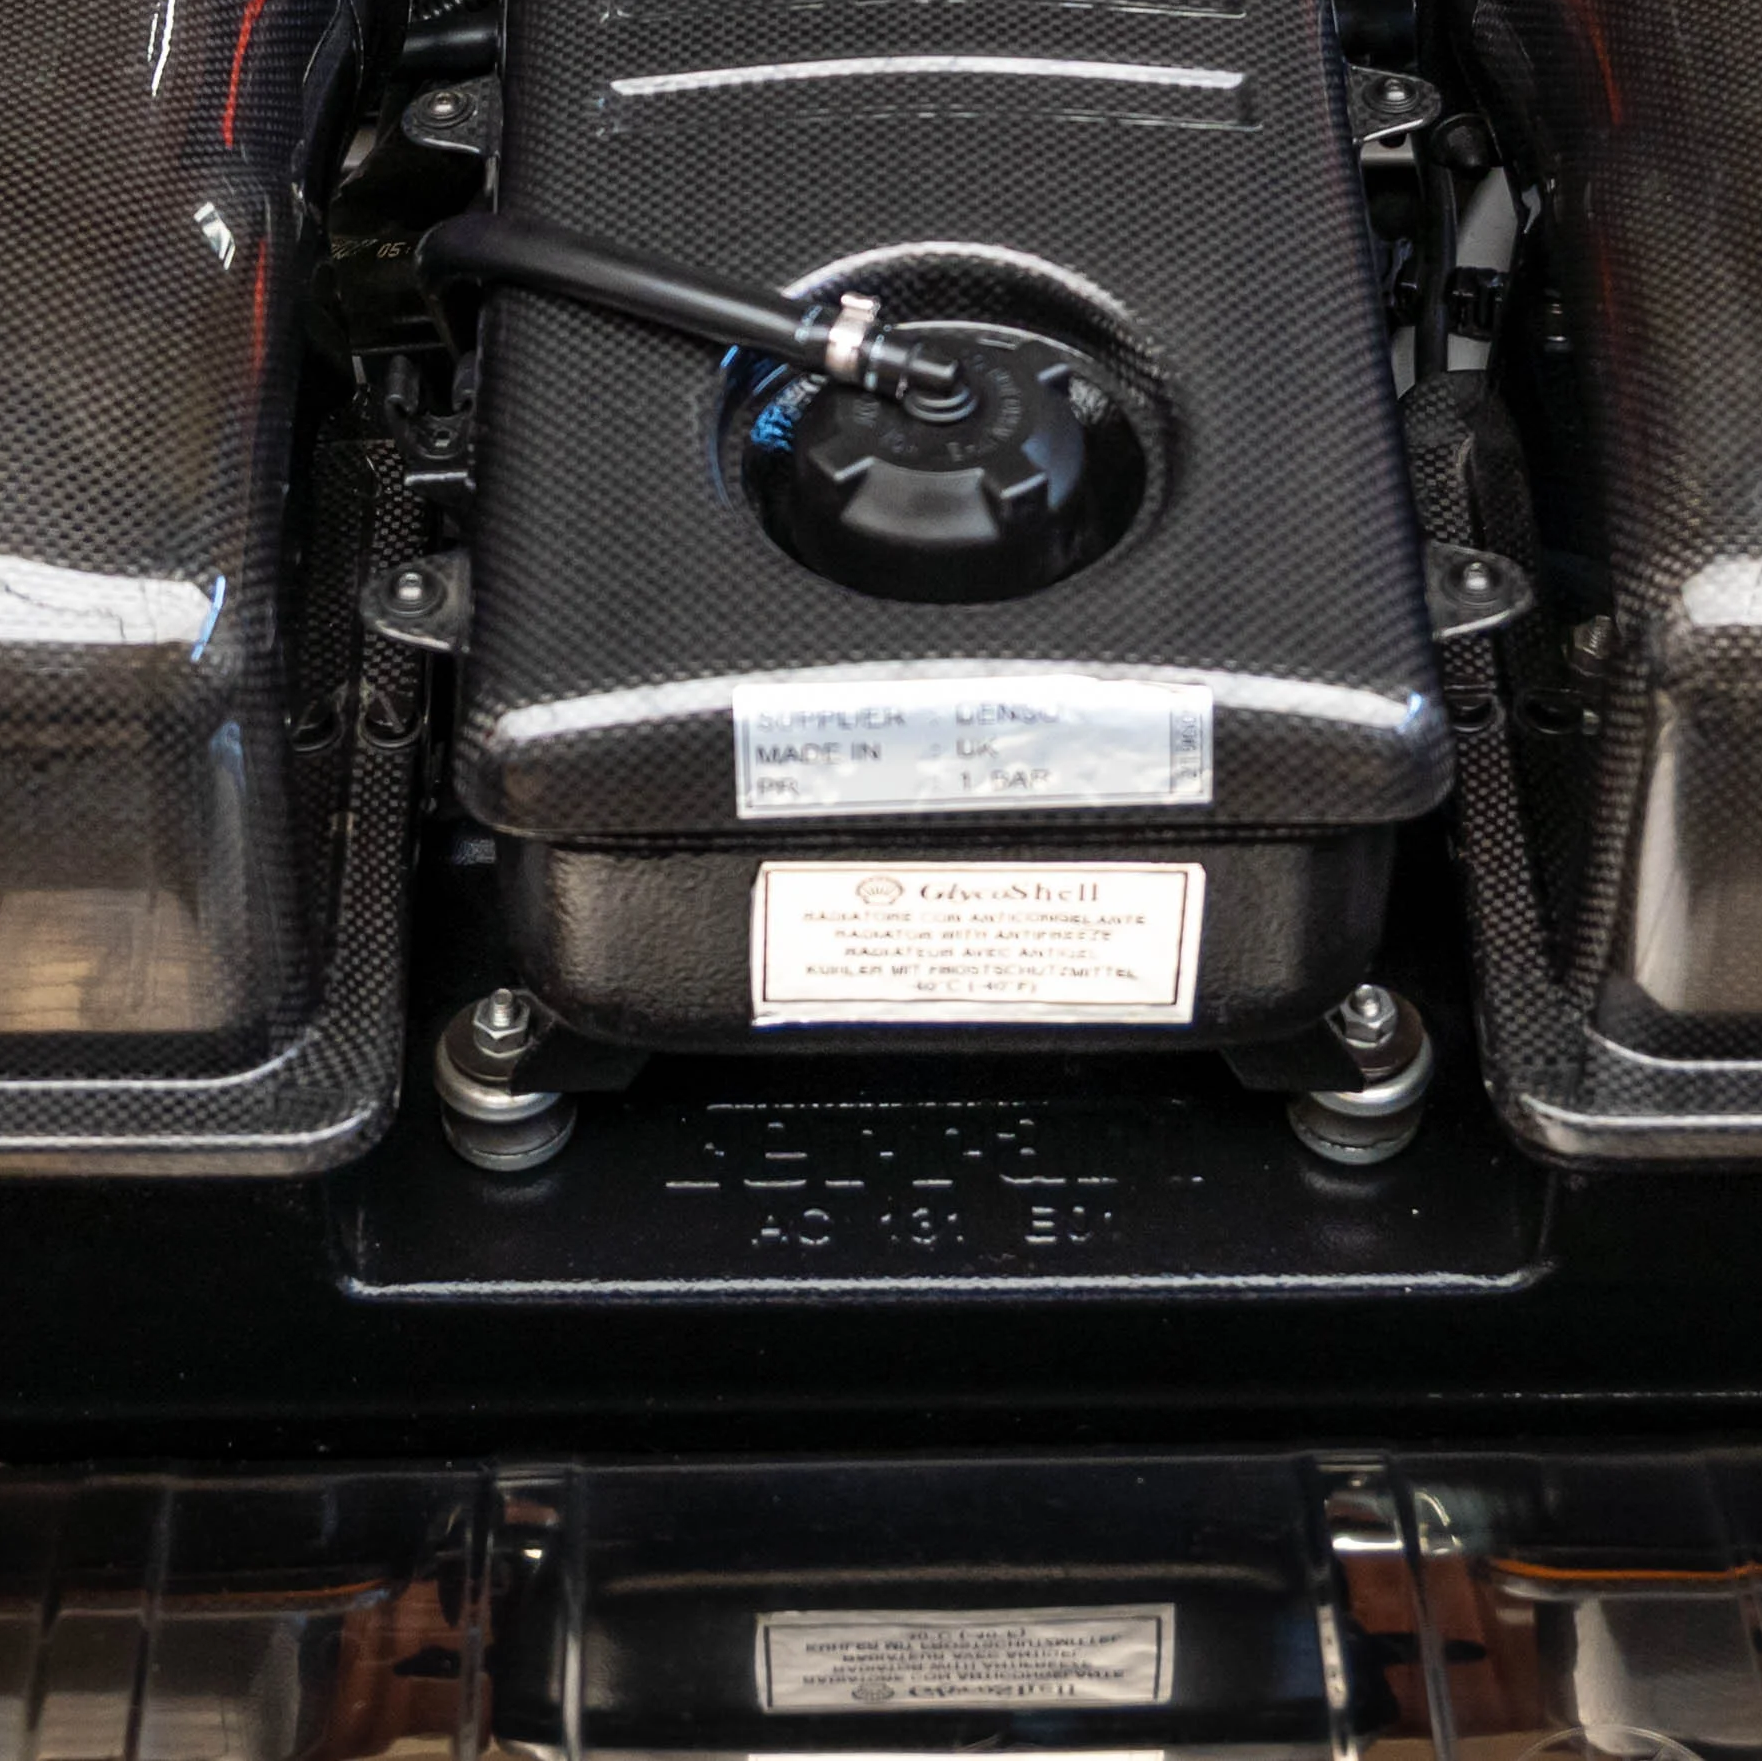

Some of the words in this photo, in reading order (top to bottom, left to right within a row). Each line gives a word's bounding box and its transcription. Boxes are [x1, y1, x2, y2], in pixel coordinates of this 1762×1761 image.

[756, 708, 906, 732] SUPPLIER
[755, 742, 840, 764] MADE
[851, 741, 882, 762] IN
[956, 736, 999, 758] UK
[756, 776, 800, 795] PR
[990, 768, 1051, 791] BAR
[920, 882, 1099, 904] GlycoShell
